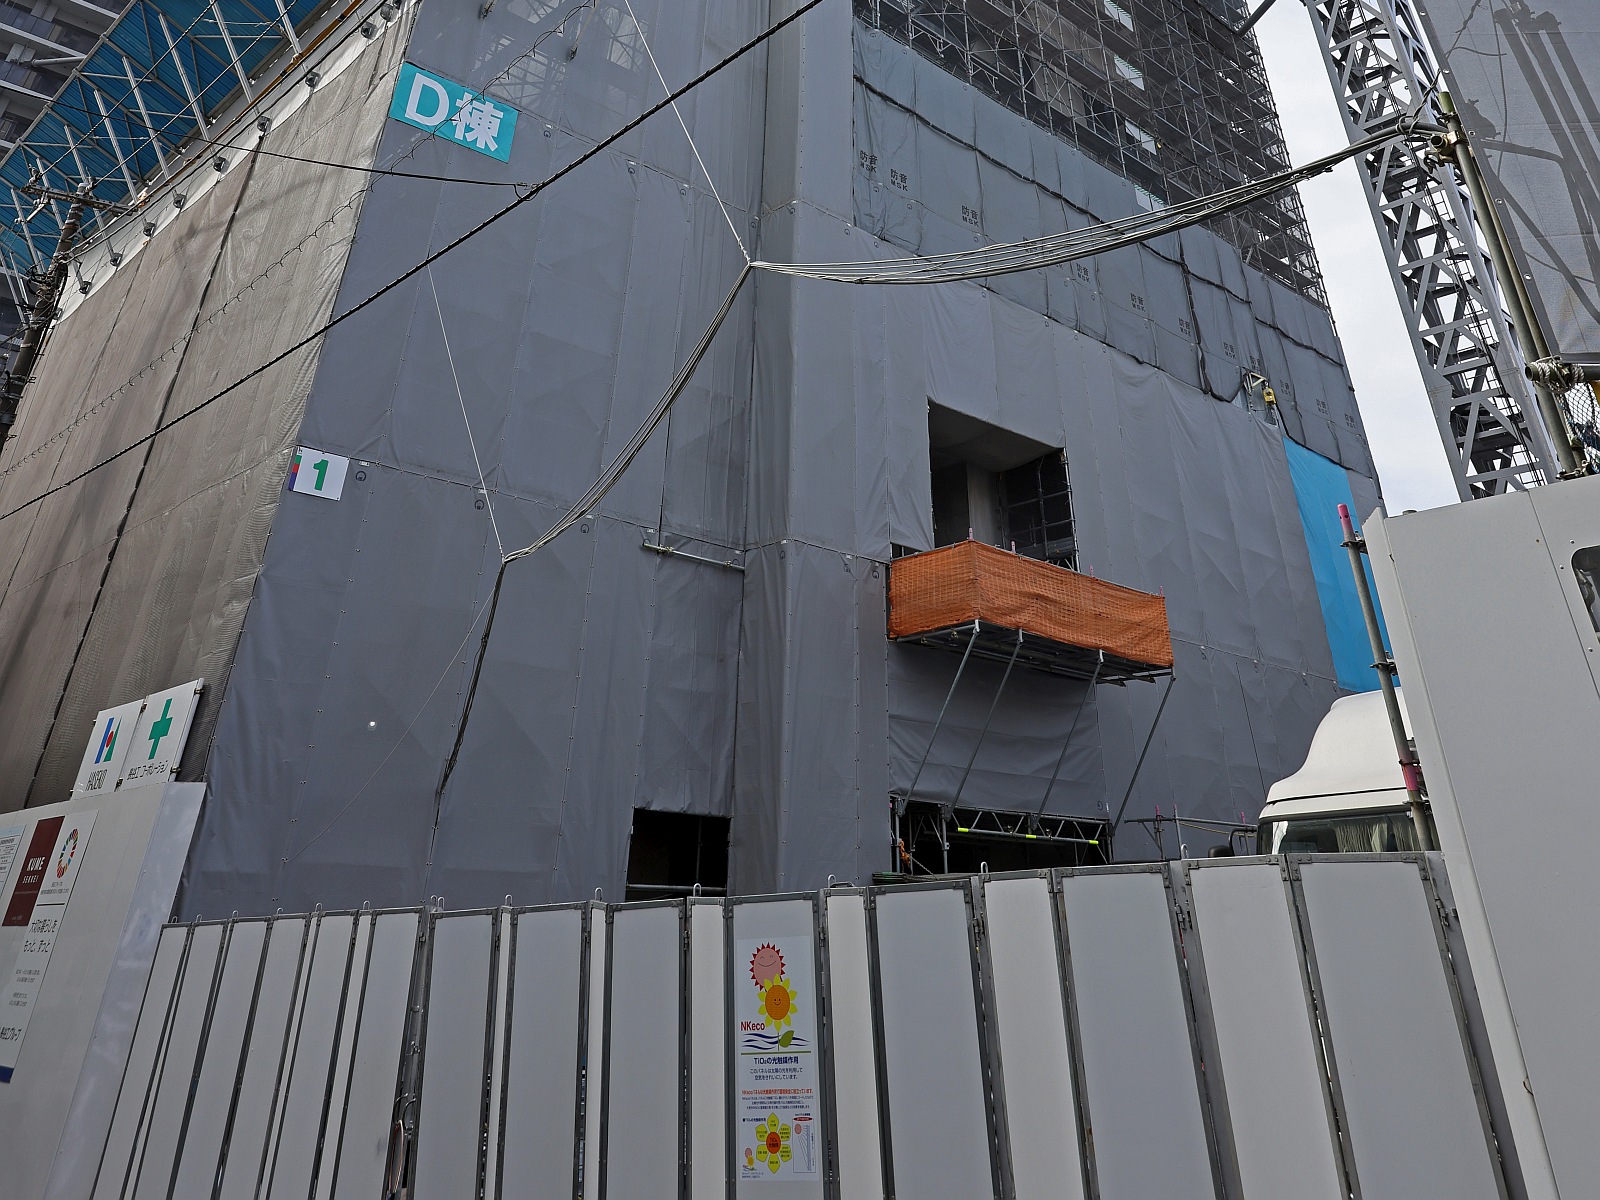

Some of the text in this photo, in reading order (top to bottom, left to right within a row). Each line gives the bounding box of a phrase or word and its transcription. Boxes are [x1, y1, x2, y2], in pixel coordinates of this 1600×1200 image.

[404, 71, 504, 153] D棟
[860, 150, 878, 166] 防音
[890, 168, 908, 184] 防音
[961, 205, 979, 220] 防音
[312, 458, 329, 491] 1
[26, 856, 46, 871] KUME
[740, 1020, 766, 1031] NKeco
